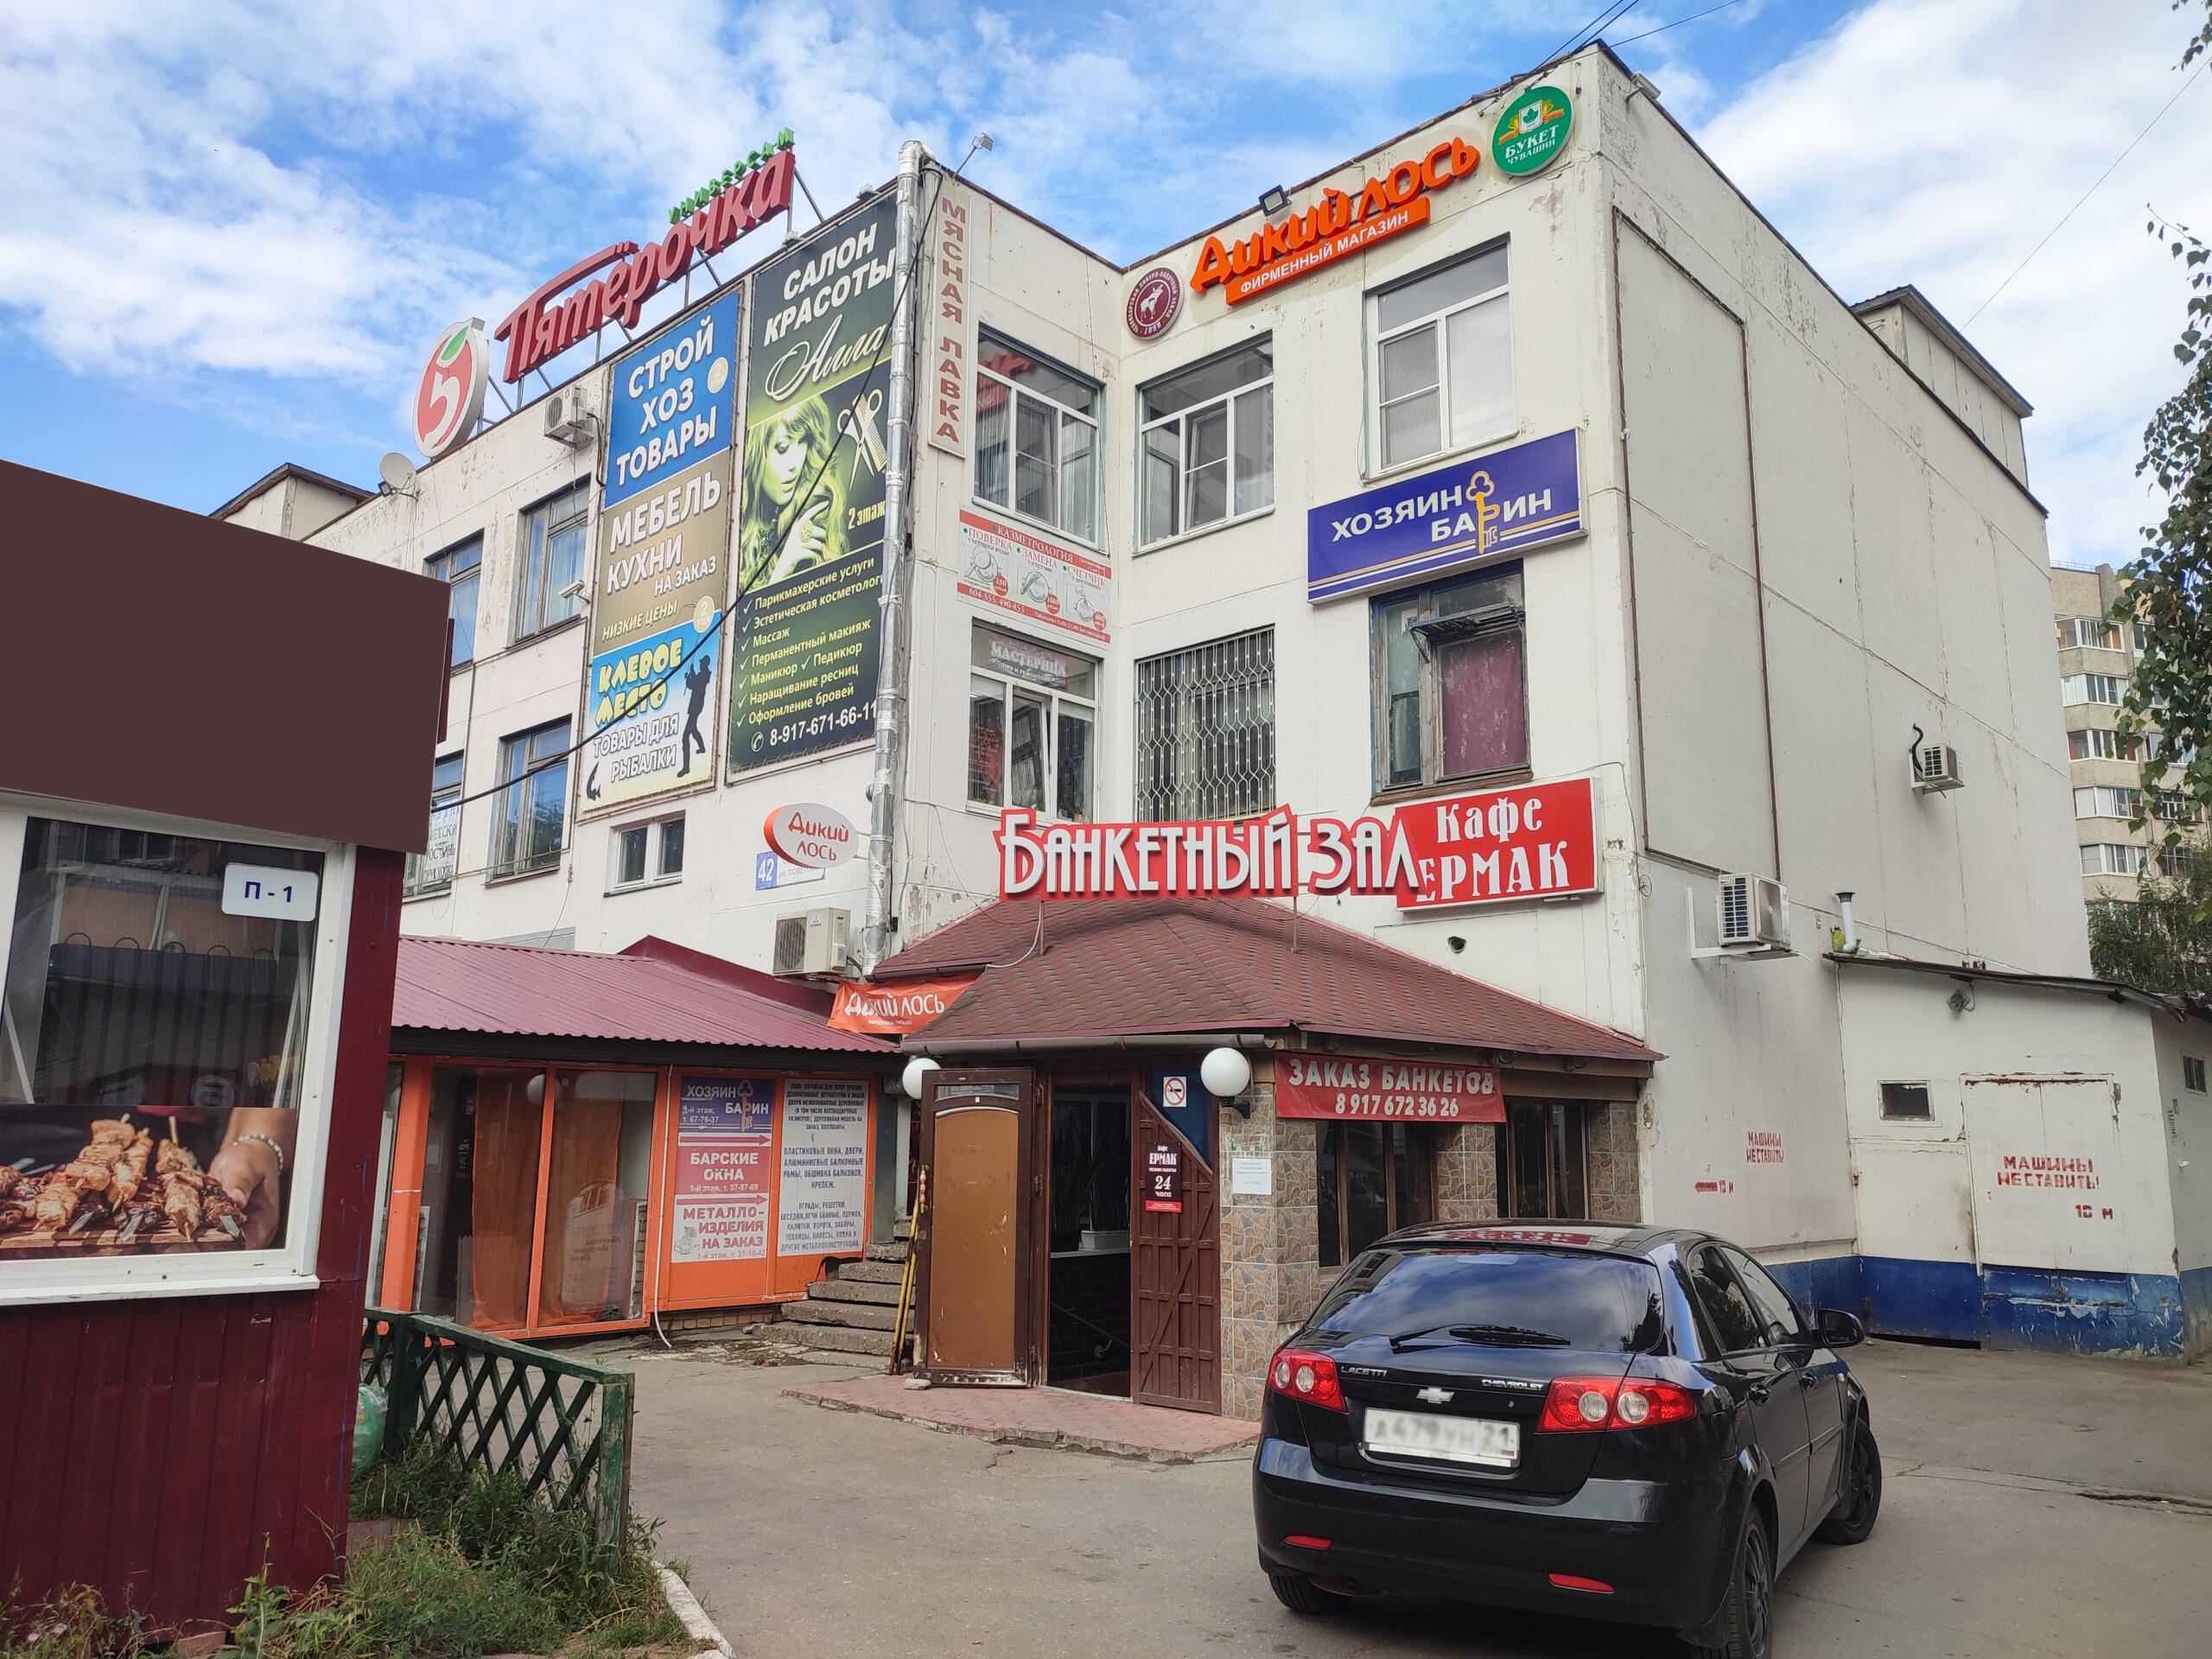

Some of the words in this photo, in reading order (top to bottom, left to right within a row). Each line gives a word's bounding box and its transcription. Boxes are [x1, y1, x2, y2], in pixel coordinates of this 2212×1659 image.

[1505, 124, 1559, 159] БУКЕТ
[1508, 138, 1555, 164] ЧУВАШИИ
[669, 127, 795, 224] УНИВЕРСАМ
[1190, 187, 1352, 295] Дикий
[1240, 242, 1334, 294] ФИРМЕННЫЙ
[1337, 210, 1408, 252] МАГАЗИН
[784, 222, 878, 301] САЛОН
[941, 197, 966, 325] МЯСНАЯ
[764, 247, 896, 346] КРАСОТЫ
[628, 315, 714, 399] СТРОЙ
[640, 378, 694, 435] ХОЗ
[936, 336, 963, 444] ЛАВКА
[616, 405, 716, 487] ТОВАРЫ
[610, 471, 721, 553] МЕБЕЛЬ
[848, 507, 855, 531] 2
[1331, 485, 1462, 543] ХОЗЯИН
[1431, 484, 1552, 550] БАРИН
[969, 528, 1012, 551] ПОВЕРКА
[997, 525, 1074, 563] КАЗМЕТРОЛОГИЯ
[1023, 548, 1058, 569] ЗАМЕНА
[607, 533, 683, 594] КУХНИ
[654, 574, 672, 597] НА
[675, 555, 716, 588] ЗАКАЗ
[995, 577, 1007, 587] 250
[1067, 566, 1105, 587] СЧЕТЧИК
[754, 571, 838, 611] Парикмахерские
[839, 557, 875, 583] услуги
[1046, 596, 1059, 605] 1000
[602, 612, 644, 642] НИЗКИЕ
[645, 598, 678, 627] ЦЕНЫ
[753, 597, 817, 630] Эстетическая
[752, 632, 826, 669] Перманентный
[829, 618, 872, 645] макияж
[753, 627, 791, 648] Массаж
[598, 638, 683, 694] КЛЕВОЕ
[750, 663, 798, 689] Маникюр
[813, 642, 862, 669] Педикюр
[991, 641, 1066, 677] МАСТЕРИЦА
[594, 678, 667, 728] МЕСТО
[748, 699, 813, 727] Оформление
[815, 682, 854, 708] бровей
[749, 677, 818, 708] Наращивание
[821, 663, 859, 685] ресниц
[593, 720, 647, 760] ТОВАРЫ
[651, 712, 679, 743] ДЛЯ
[611, 744, 677, 783] РЫБАЛКИ
[788, 811, 849, 842] Дикий
[1436, 797, 1541, 844] Кафе
[758, 858, 775, 881] 42
[1314, 815, 1420, 890] ЗАЛ
[1416, 842, 1571, 903] ЕРМАК
[686, 1085, 736, 1098] ХОЗЯИН
[1288, 1058, 1371, 1090] ЗАКАЗ
[1382, 1065, 1494, 1096] БАНКЕТОВ
[725, 1101, 769, 1116] БАРИН
[1335, 1093, 1346, 1114] 8
[1350, 1094, 1380, 1115] 917
[1384, 1095, 1414, 1116] 672
[1418, 1097, 1437, 1116] 36
[1440, 1098, 1459, 1117] 26
[1748, 1131, 1782, 1147] МАШИНЫ
[690, 1152, 759, 1166] БАРСКИЕ
[703, 1168, 745, 1181] ОКНА
[784, 1158, 828, 1166] АЛЮМИНИЕВЫЕ
[1149, 1153, 1178, 1166] ЕРМАК
[2003, 1155, 2094, 1173] МАШИНЫ
[1154, 1175, 1172, 1190] 24
[683, 1206, 765, 1220] МЕТАЛЛО-
[698, 1220, 764, 1236] ИЗДЕЛИЯ
[702, 1237, 720, 1249] НА
[723, 1236, 764, 1248] ЗАКАЗ
[1340, 1365, 1388, 1377] LACETTI
[1481, 1378, 1544, 1391] CHEVROLET
